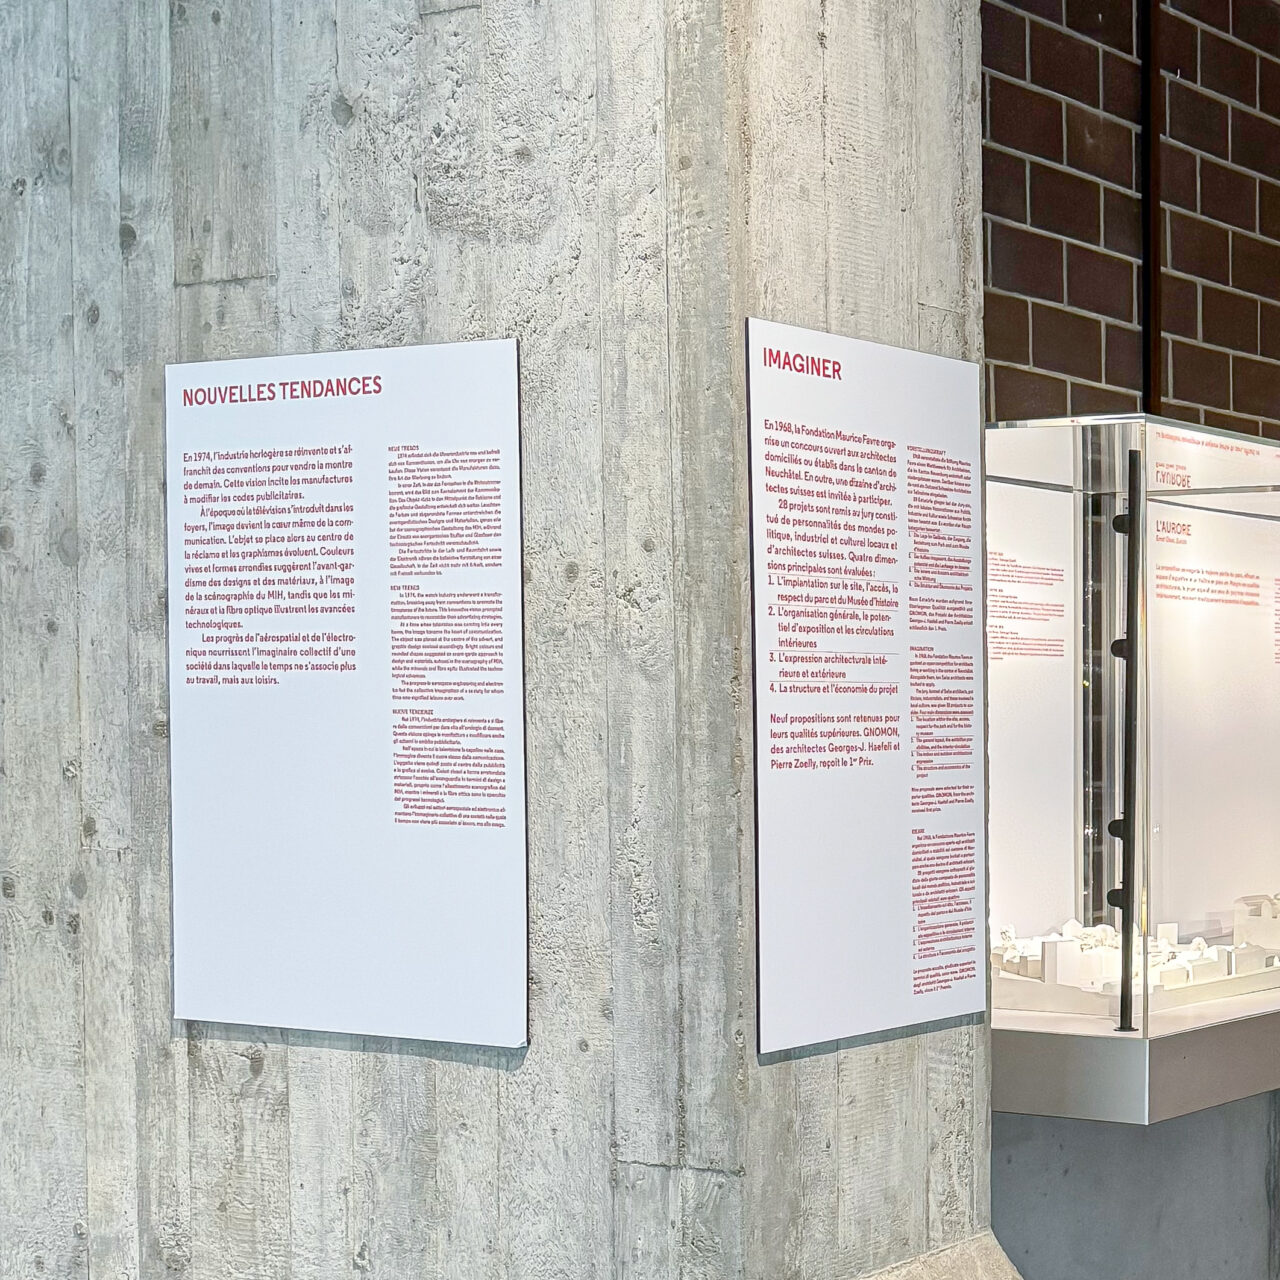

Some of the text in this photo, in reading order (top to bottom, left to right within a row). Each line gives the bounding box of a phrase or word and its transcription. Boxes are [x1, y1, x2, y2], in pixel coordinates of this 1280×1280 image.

[763, 347, 842, 380] IMAGINER
[183, 375, 382, 407] NOUVELLES TENDANCES
[774, 420, 793, 434] 1968,
[801, 424, 835, 439] Fondation
[834, 430, 862, 443] Maurice
[862, 434, 880, 445] Favre
[193, 452, 212, 462] 1974,
[213, 450, 248, 460] l'industrie
[249, 448, 284, 460] horlogère
[293, 447, 328, 456] réinvente
[790, 441, 823, 453] concours
[823, 446, 846, 456] ouvert
[859, 450, 896, 463] architectes
[183, 460, 352, 476] franchit conventions pour vendre montre
[764, 451, 802, 465] domiciliés
[838, 461, 855, 472] dans
[223, 478, 244, 488] Cette
[245, 478, 266, 487] vision
[267, 477, 289, 486] incite
[301, 474, 353, 484] manufactures
[814, 474, 835, 486] outre,
[189, 490, 304, 503] modifier codes publicitaires.
[765, 483, 892, 507] tectes suisses invitée participer.
[287, 503, 324, 514] s'introduit
[325, 503, 342, 512] dans
[788, 501, 814, 513] projets
[815, 505, 830, 514] sont
[184, 522, 207, 533] foyers,
[208, 521, 235, 532] l'image
[235, 520, 263, 530] devient
[857, 524, 885, 534] mondes
[1156, 520, 1191, 536] L'AURORE
[184, 533, 342, 546] munication. L'objet place alors centre
[766, 528, 792, 541] litique,
[867, 538, 889, 549] locaux
[191, 550, 220, 559] réclame
[283, 547, 318, 557] évoluent.
[319, 546, 354, 556] Couleurs
[766, 544, 817, 558] d'architectes
[818, 549, 846, 560] suisses.
[874, 553, 898, 564] dimen-
[212, 563, 237, 573] formes
[238, 562, 272, 572] arrondies
[312, 561, 354, 572] l'avant-gar-
[767, 560, 786, 571] sions
[787, 562, 826, 574] principales
[827, 566, 842, 575] sont
[184, 575, 354, 588] disme designs matériaux, l'image
[849, 581, 864, 592] site,
[287, 590, 311, 599] tandis
[777, 594, 803, 606] respect
[814, 596, 829, 607] parc
[847, 595, 868, 606] Musée
[185, 606, 209, 615] néraux
[244, 605, 273, 615] optique
[777, 606, 828, 619] L'organisation
[829, 609, 861, 621] générale,
[778, 622, 894, 636] tiel d'exposition circulations
[215, 633, 243, 644] progrès
[321, 632, 355, 642] l'électro-
[778, 637, 817, 648] intérieures
[185, 646, 356, 658] nique nourrissent l'imaginaire collectif d'une
[778, 653, 822, 664] L'expression
[185, 661, 356, 672] société dans laquelle temps s'associe plus
[810, 668, 846, 678] extérieure
[195, 675, 279, 685] travail, mais loisirs.
[789, 684, 821, 693] structure
[878, 684, 898, 695] projet
[770, 713, 788, 723] Neuf
[789, 713, 835, 725] propositions
[836, 714, 851, 723] sont
[884, 715, 900, 724] pour
[770, 729, 788, 739] leurs
[819, 728, 861, 739] supérieures.
[863, 727, 899, 737] GNOMON,
[785, 743, 826, 754] architectes
[770, 759, 792, 769] Pierre
[858, 756, 873, 766] Prix.
